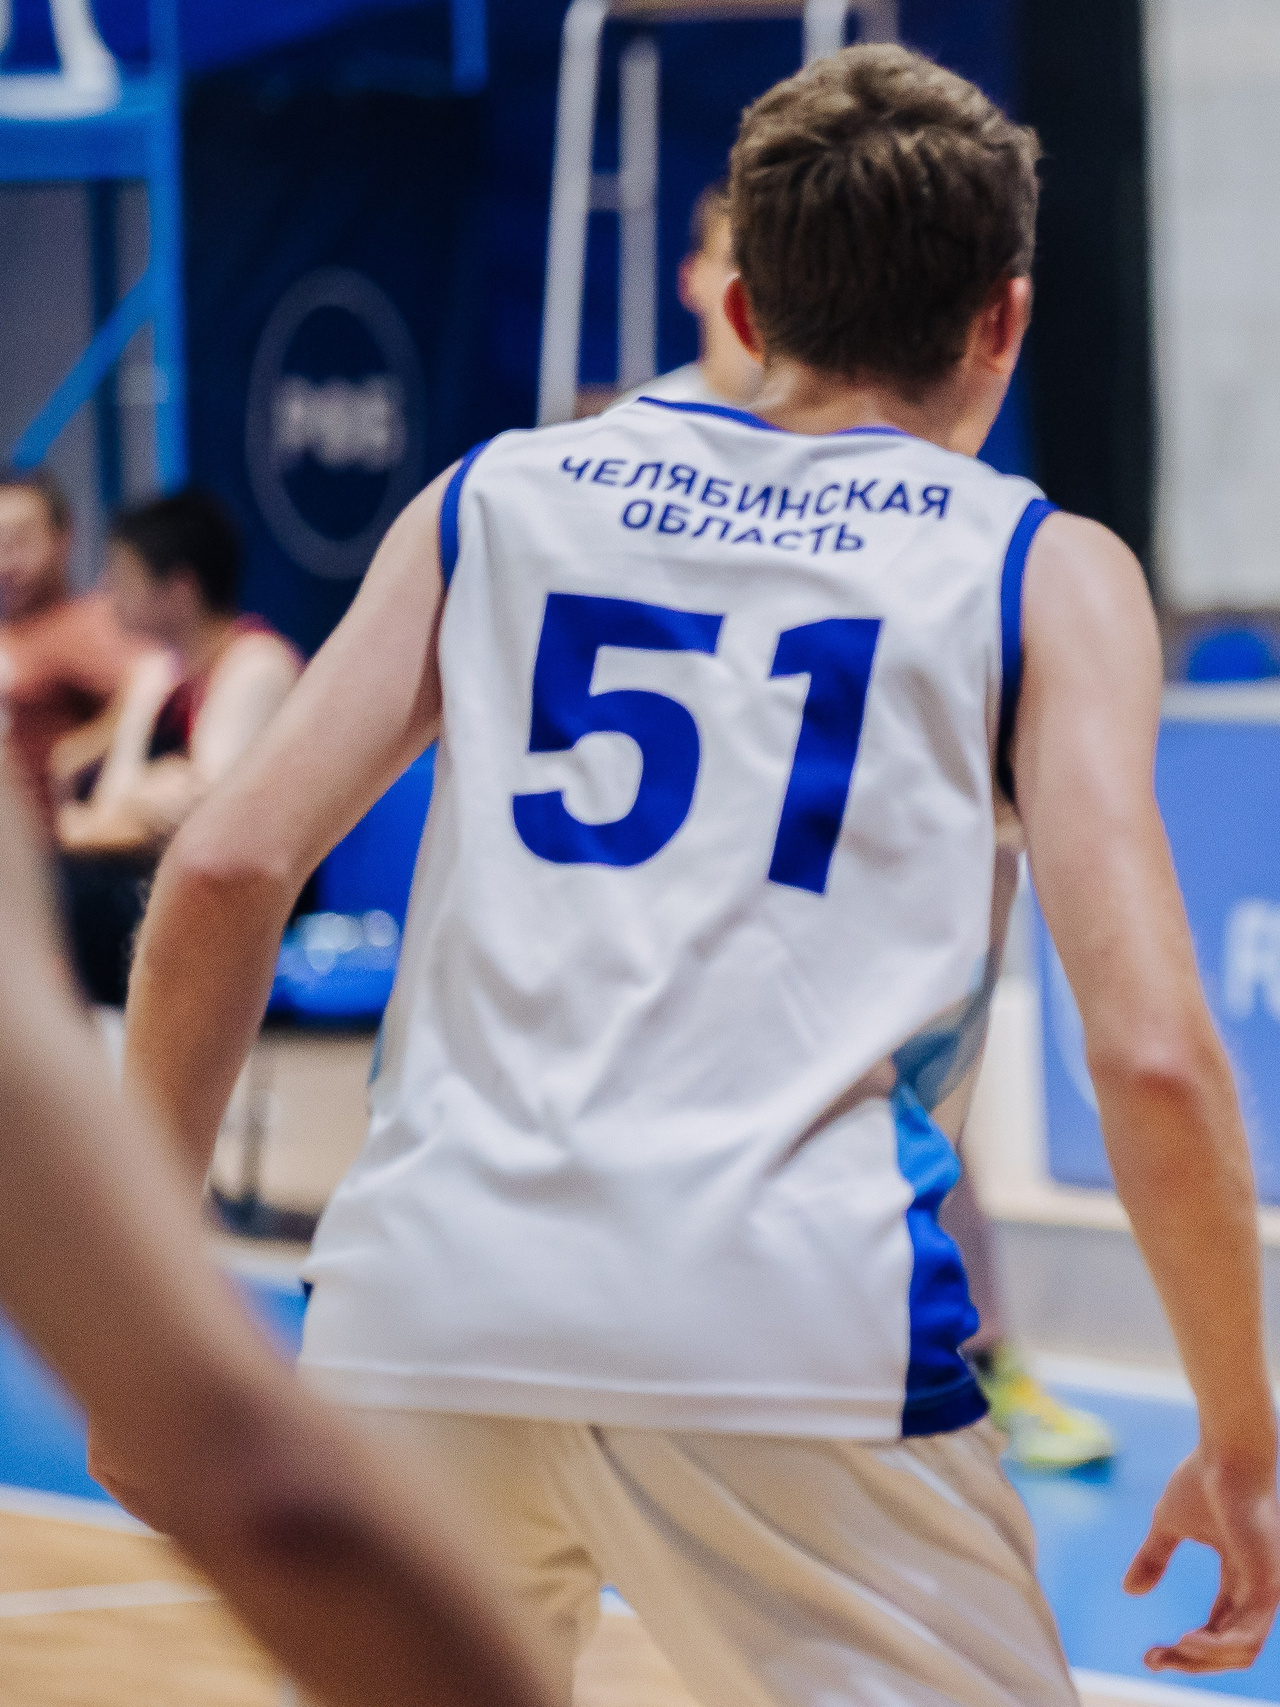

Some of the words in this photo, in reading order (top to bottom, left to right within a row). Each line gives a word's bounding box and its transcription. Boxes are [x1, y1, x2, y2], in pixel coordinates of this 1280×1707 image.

[559, 455, 953, 521] ЧЕЛЯБИНСКАЯ
[620, 499, 866, 555] ОБЛАСТЬ
[511, 592, 883, 896] 51
